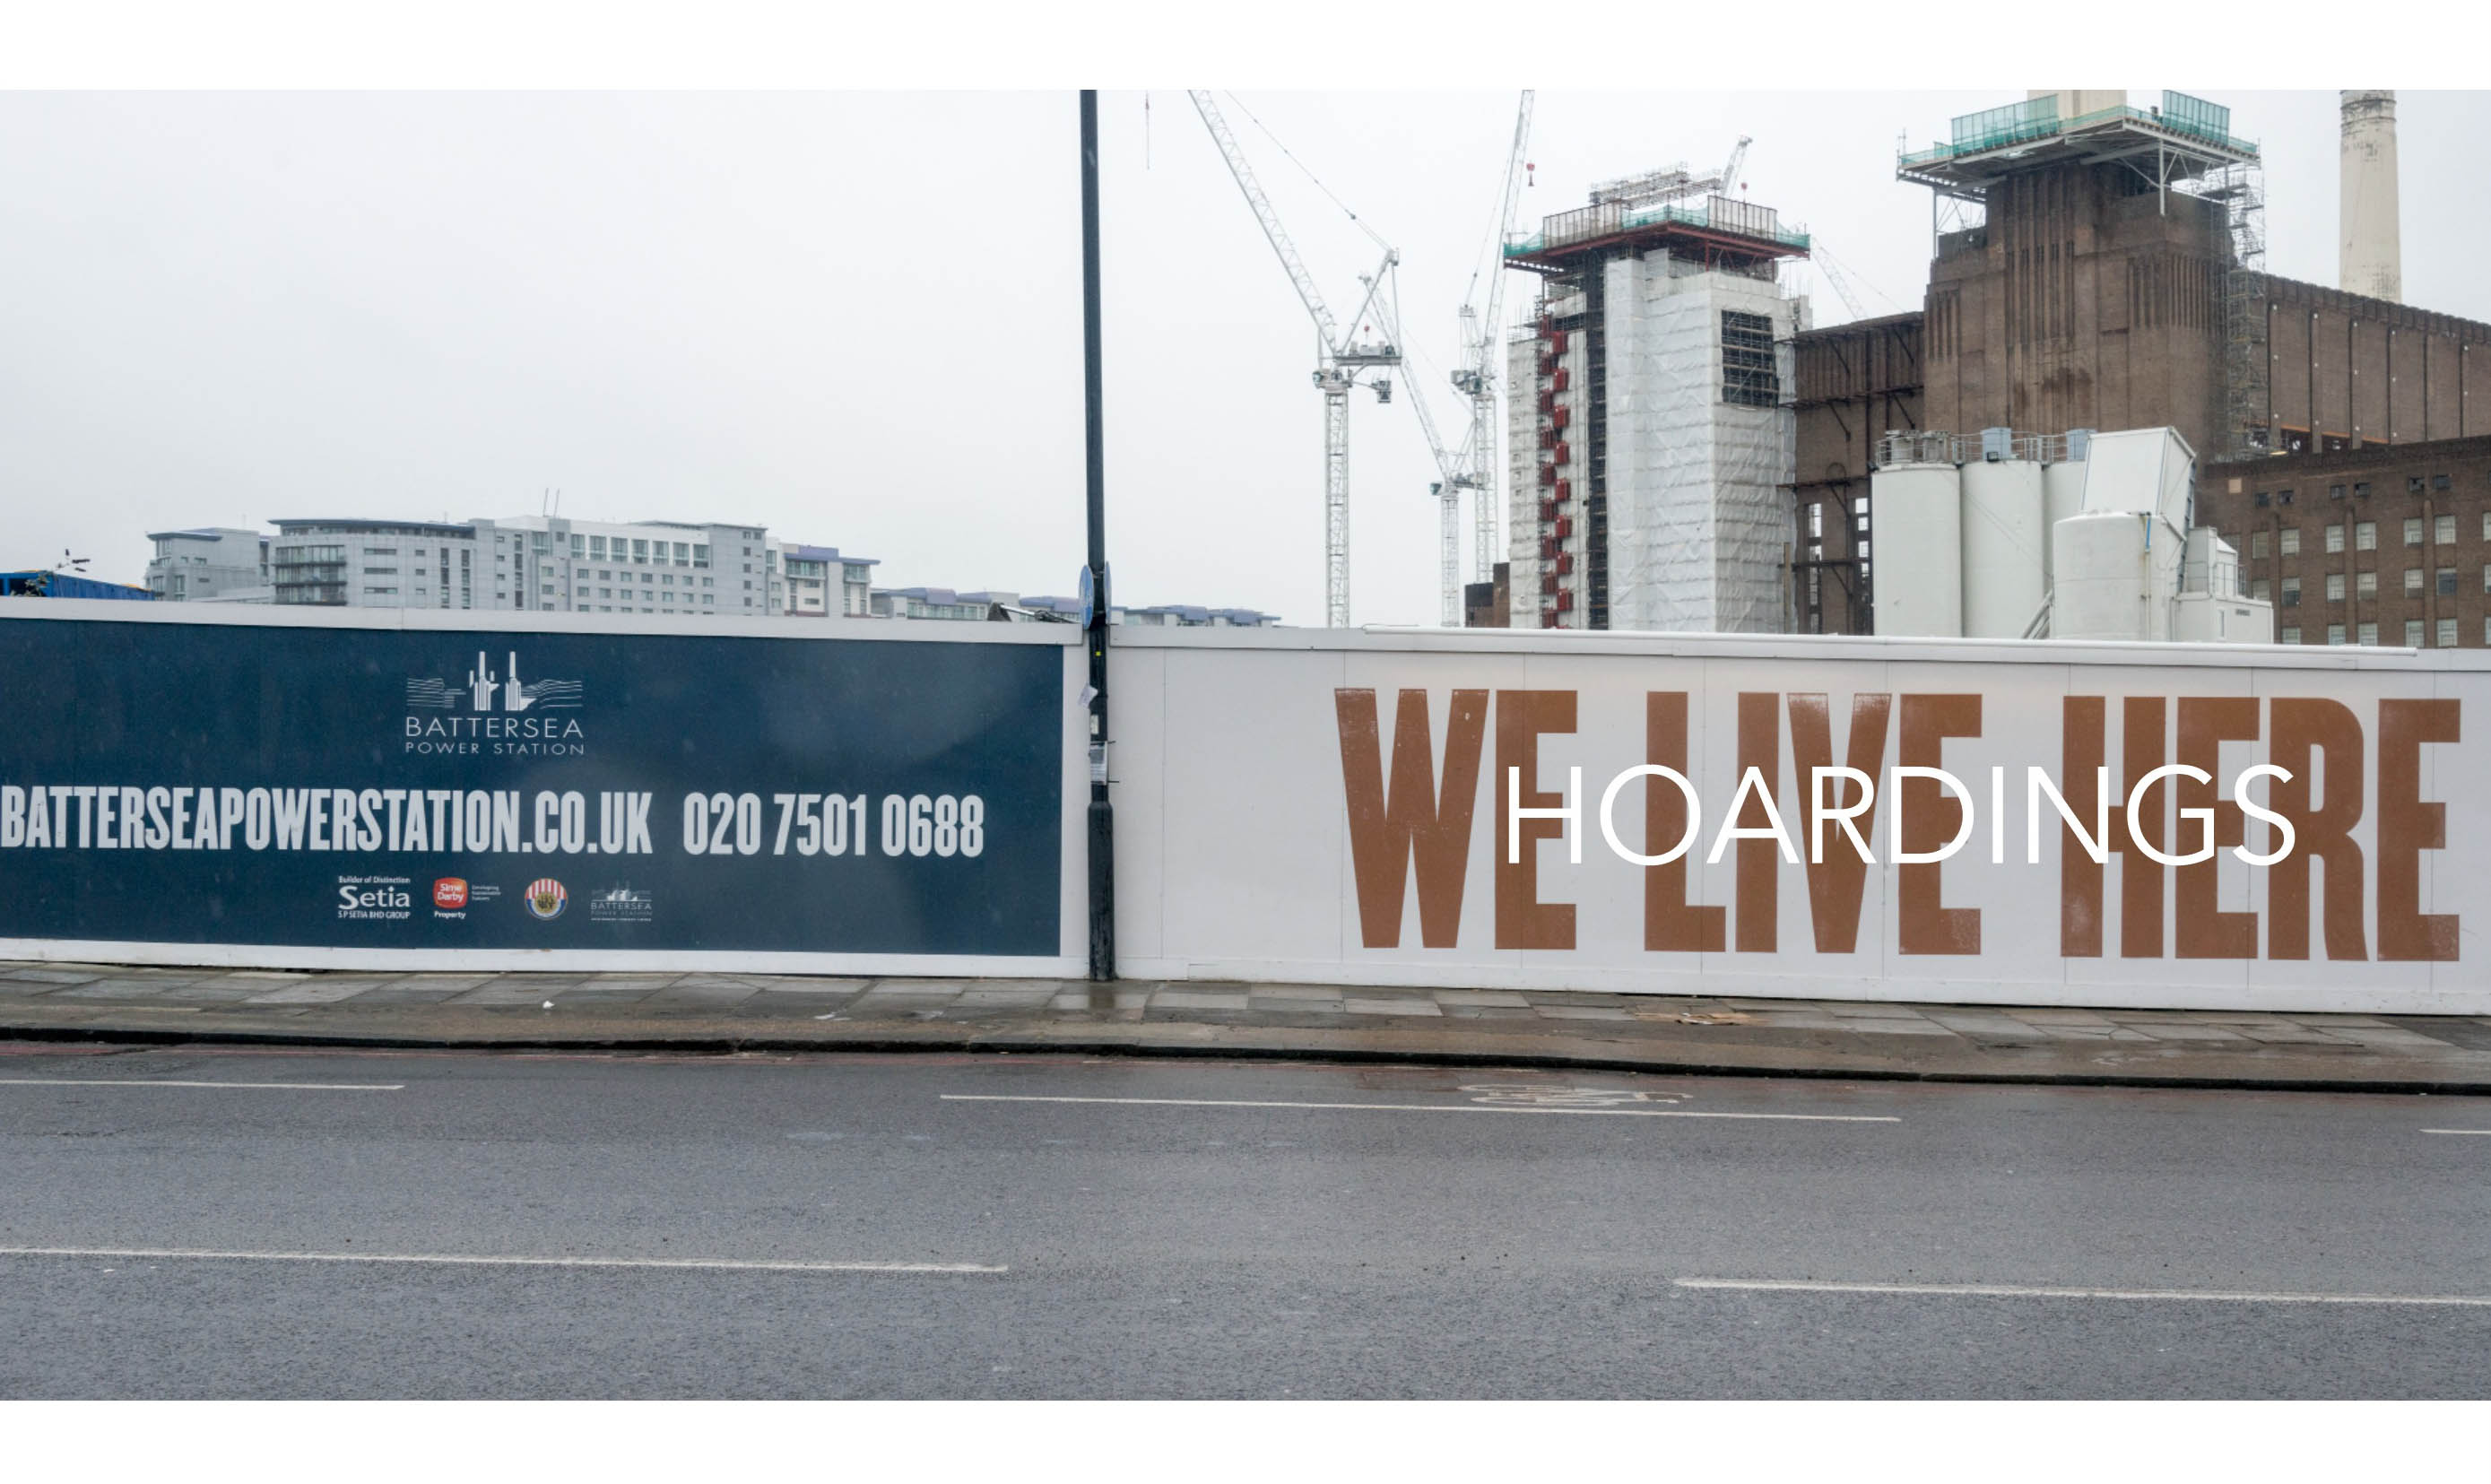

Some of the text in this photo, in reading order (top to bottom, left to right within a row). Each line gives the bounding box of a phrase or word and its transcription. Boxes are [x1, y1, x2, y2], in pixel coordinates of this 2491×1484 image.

[405, 716, 583, 738] BATTERSEA
[405, 742, 585, 755] POWER STATION
[1, 785, 984, 858] BATTERSEAPOWERSTATION.CO.UK 020 7501 0688
[1334, 688, 2461, 961] WE LIVE HERE
[338, 875, 411, 884] Builder of Distinction
[439, 883, 463, 891] Sime
[338, 885, 411, 910] Setia
[437, 891, 464, 904] Darby
[590, 902, 652, 910] BATTERSEA
[349, 910, 368, 919] SETIA
[386, 911, 411, 919] GROUP
[434, 910, 466, 920] Property
